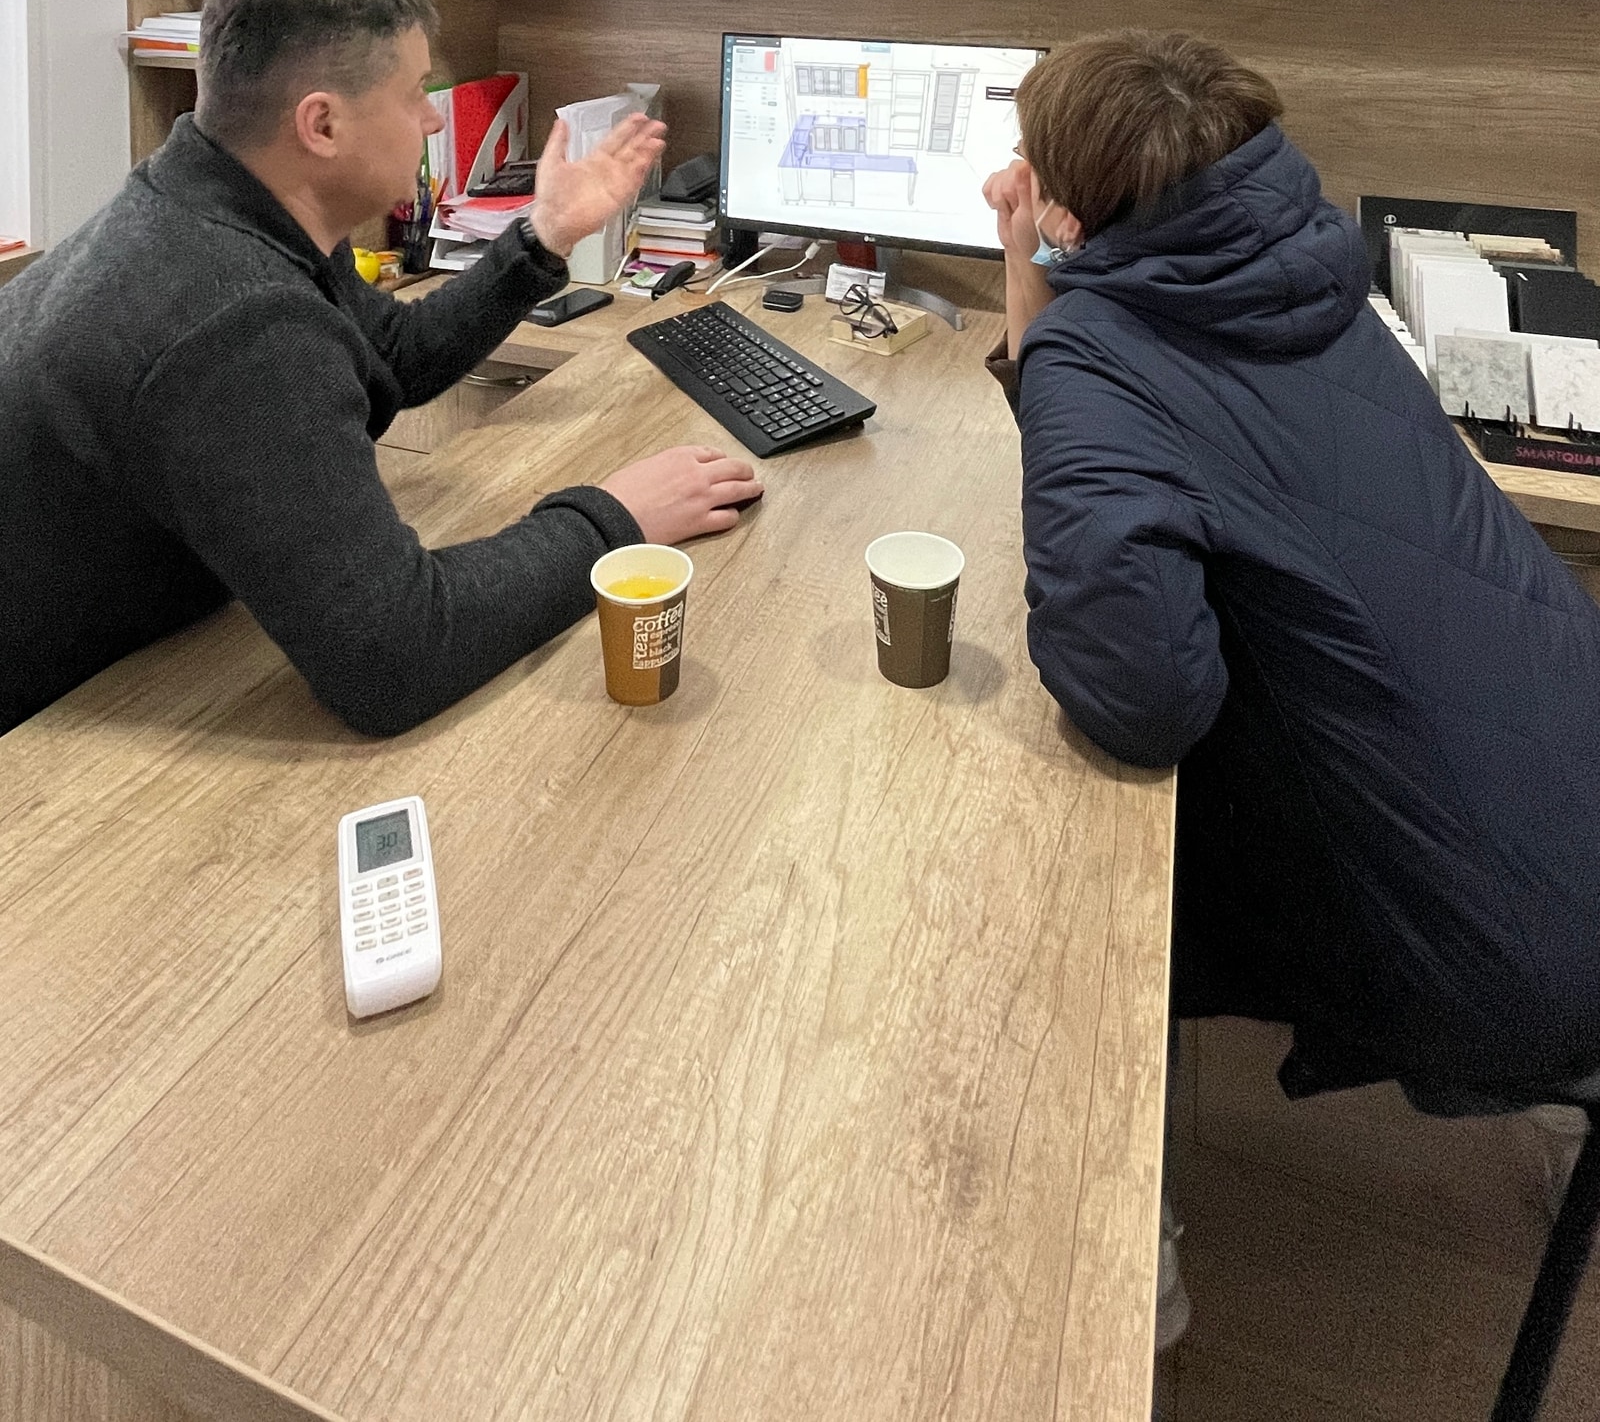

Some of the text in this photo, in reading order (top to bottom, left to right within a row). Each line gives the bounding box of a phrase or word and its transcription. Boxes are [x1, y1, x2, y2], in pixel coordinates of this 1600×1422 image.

[633, 604, 683, 632] coffee
[636, 633, 648, 659] tea
[649, 643, 672, 658] black
